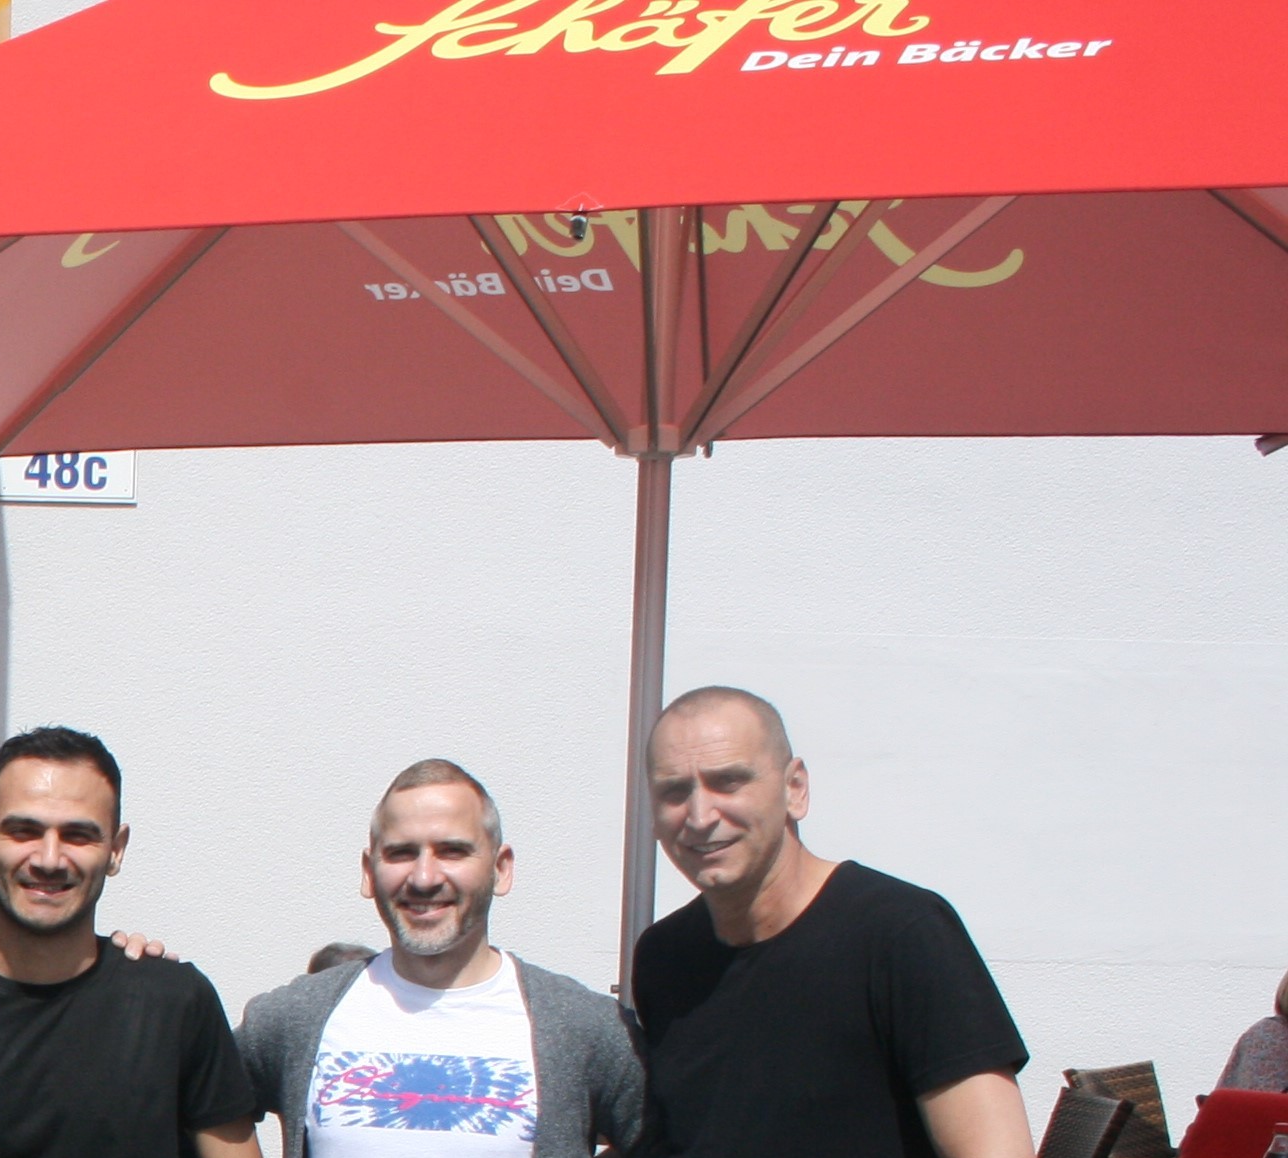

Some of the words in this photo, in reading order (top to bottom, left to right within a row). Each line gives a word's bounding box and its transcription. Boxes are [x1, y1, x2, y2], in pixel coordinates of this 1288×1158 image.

[740, 46, 880, 71] Dein
[897, 38, 1112, 65] Bäcker
[24, 453, 108, 491] 48c
